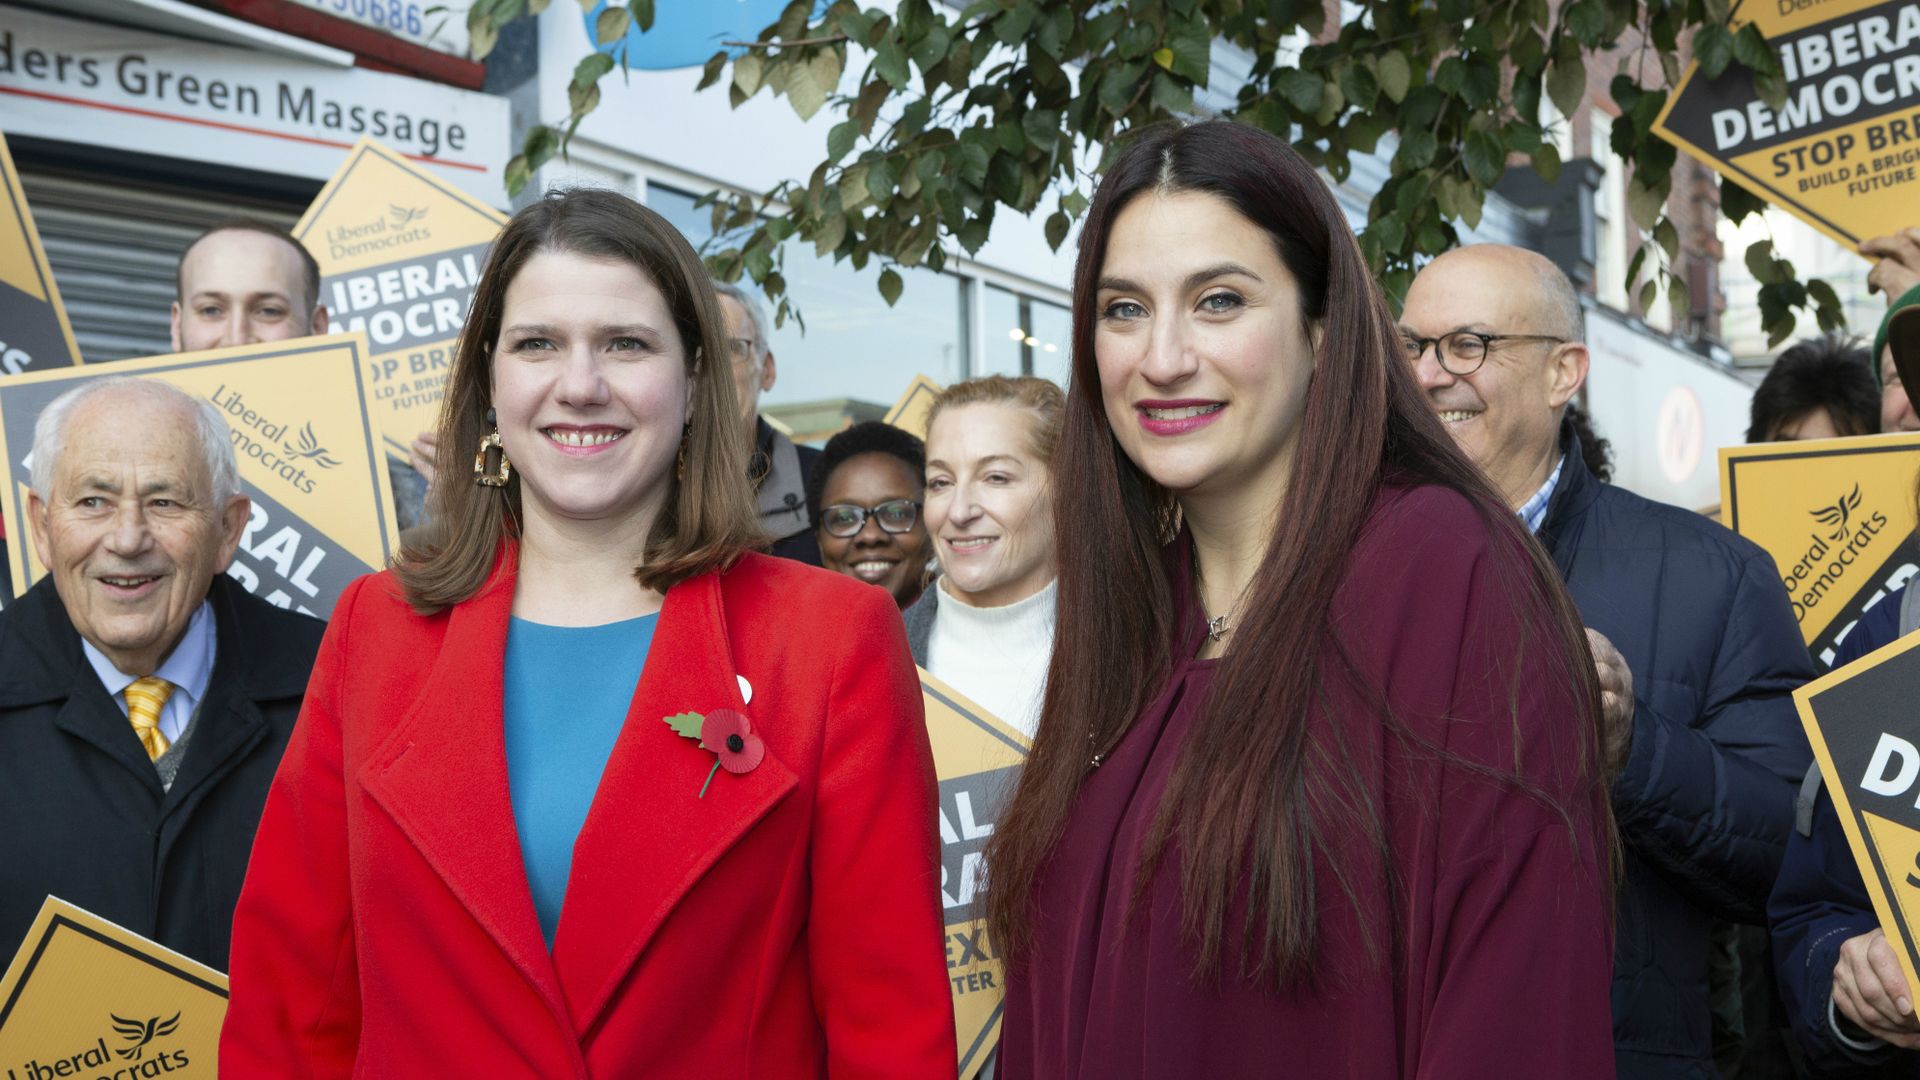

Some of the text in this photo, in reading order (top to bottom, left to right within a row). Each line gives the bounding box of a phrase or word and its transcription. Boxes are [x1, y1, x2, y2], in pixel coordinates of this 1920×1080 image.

[116, 54, 260, 116] Green
[277, 82, 467, 156] Massage
[1772, 133, 1856, 178] STOP
[1797, 167, 1851, 193] BUILD
[1856, 162, 1869, 177] A
[1847, 166, 1917, 198] FUTURE
[326, 216, 386, 244] Liberal
[330, 227, 432, 261] Democrats
[321, 253, 482, 317] IBERAL
[400, 383, 410, 395] A
[211, 384, 289, 445] Liberal
[229, 427, 318, 494] mocrats
[1860, 732, 1920, 809] D
[952, 971, 997, 995] TER
